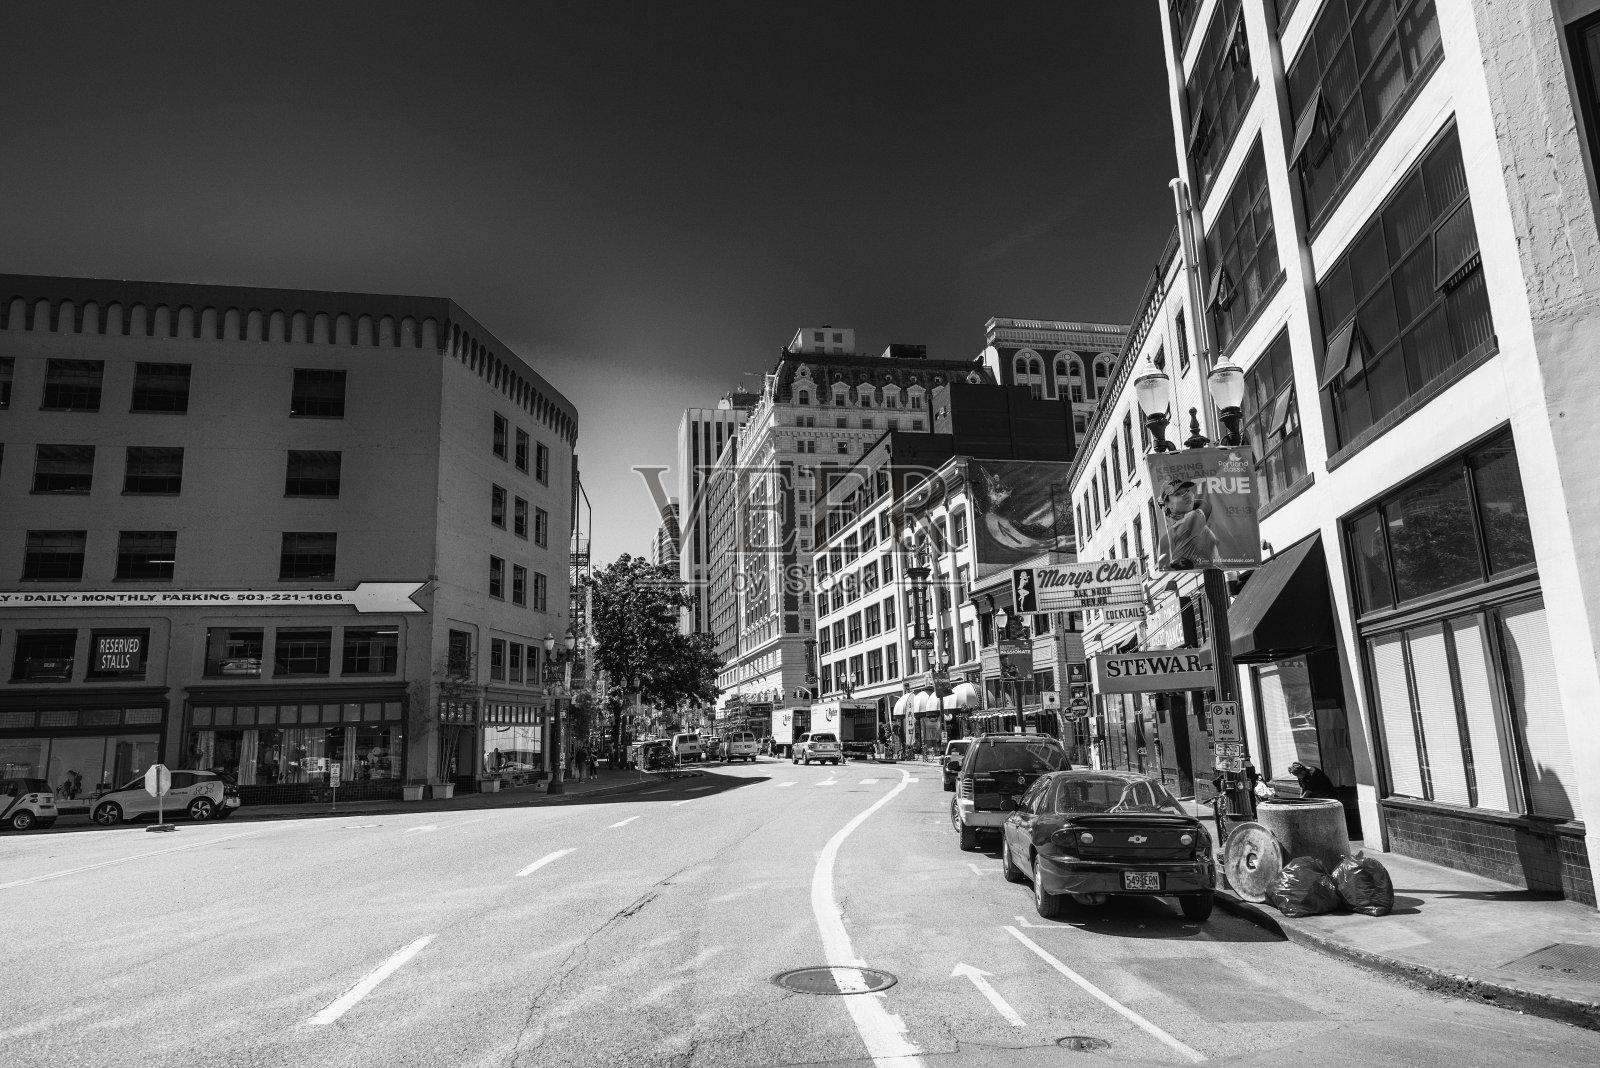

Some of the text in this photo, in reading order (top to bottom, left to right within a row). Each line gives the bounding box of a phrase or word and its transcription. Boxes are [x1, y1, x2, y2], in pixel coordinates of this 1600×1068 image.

[1155, 462, 1203, 475] KEEPING
[1156, 469, 1217, 482] PORTLAND
[1191, 476, 1251, 494] TRUE
[1038, 560, 1137, 588] Mary's Club
[24, 594, 71, 602] DAILY
[82, 594, 157, 602] MONTHLY
[162, 593, 231, 601] PARKING
[237, 593, 343, 601] 503-221-1666
[1105, 607, 1145, 620] COCKTAILS
[100, 638, 140, 653] RESERVED
[101, 654, 130, 669] STALLS
[1106, 655, 1213, 677] STEWAR
